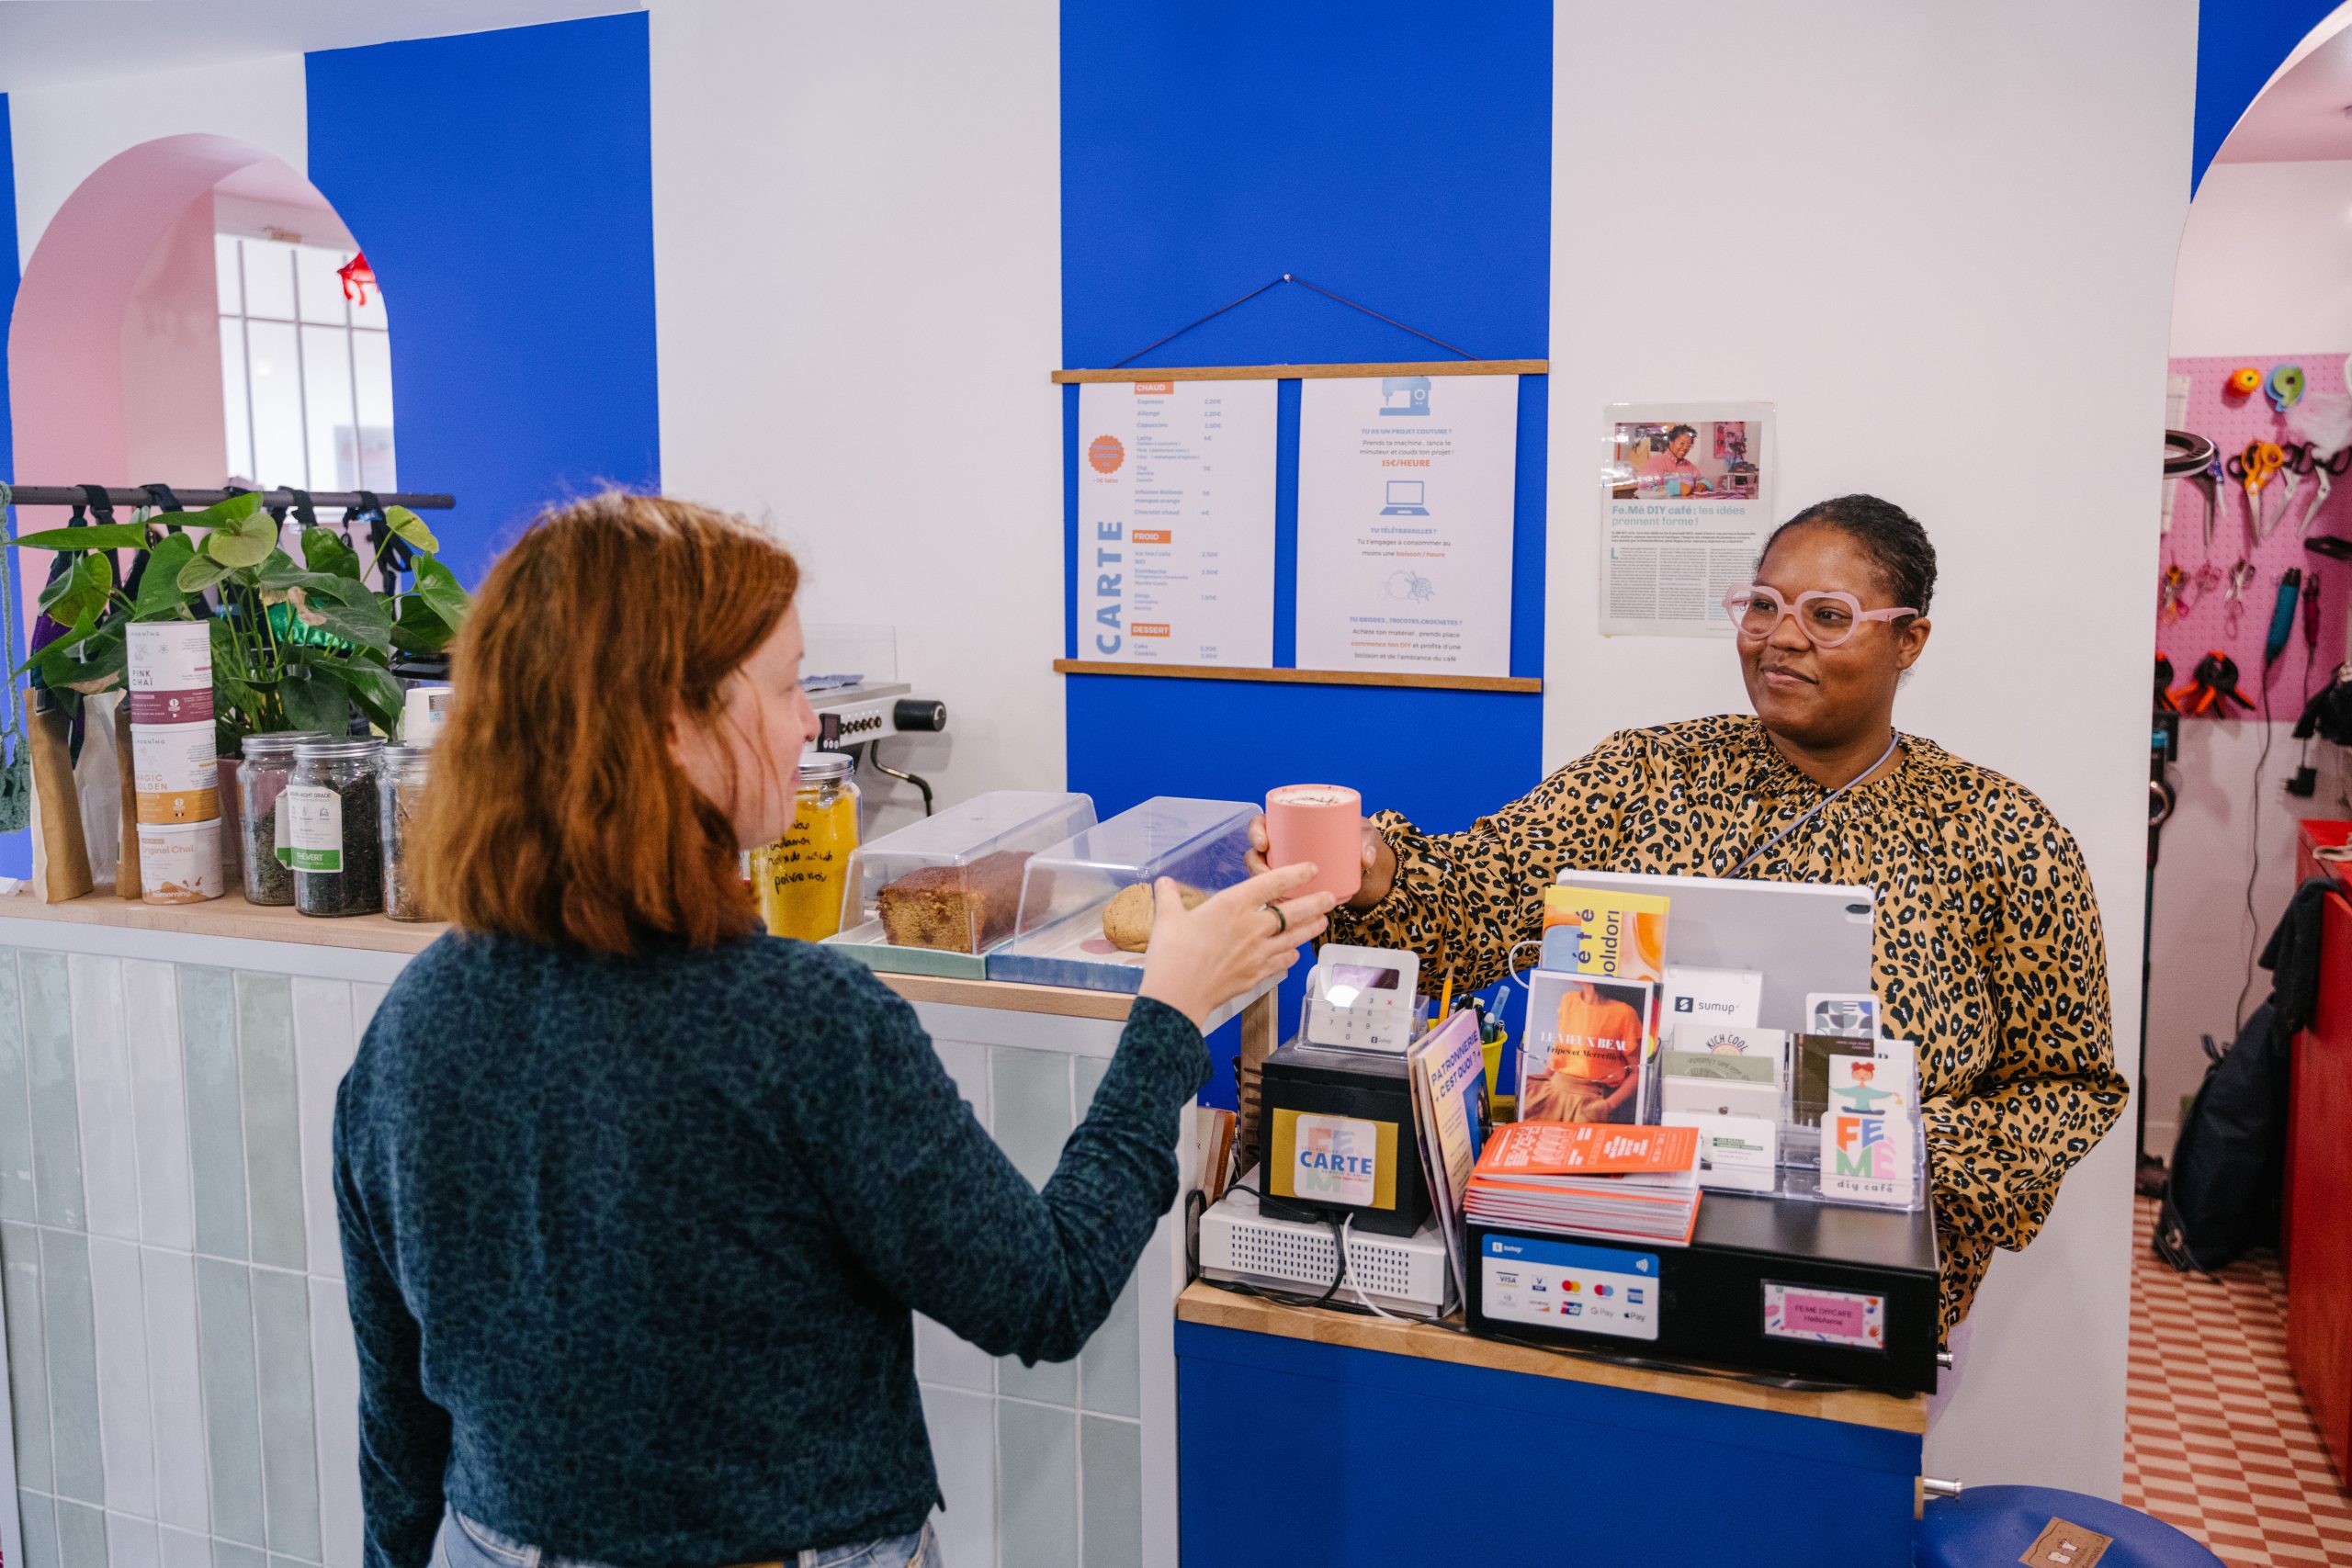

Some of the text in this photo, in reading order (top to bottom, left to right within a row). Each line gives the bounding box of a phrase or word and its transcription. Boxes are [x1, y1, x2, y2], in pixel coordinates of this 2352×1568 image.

[1646, 506, 1666, 515] DIY
[1699, 506, 1714, 515] les
[1716, 506, 1746, 515] idées
[1612, 517, 1659, 526] prennent
[1096, 522, 1123, 655] CARTE
[1133, 626, 1169, 634] DESSERT
[132, 670, 151, 678] PINK
[1698, 1000, 1736, 1014] sumup
[1727, 1034, 1749, 1052] COOL
[1430, 1030, 1478, 1087] PATRONNERIE
[1457, 1055, 1474, 1079] QUOI
[1837, 1116, 1885, 1152] FE
[1300, 1150, 1373, 1175] CARTE
[1838, 1180, 1893, 1193] diy café
[1499, 1275, 1517, 1284] VISA
[1600, 1307, 1614, 1318] Pay
[1630, 1312, 1645, 1323] Pay
